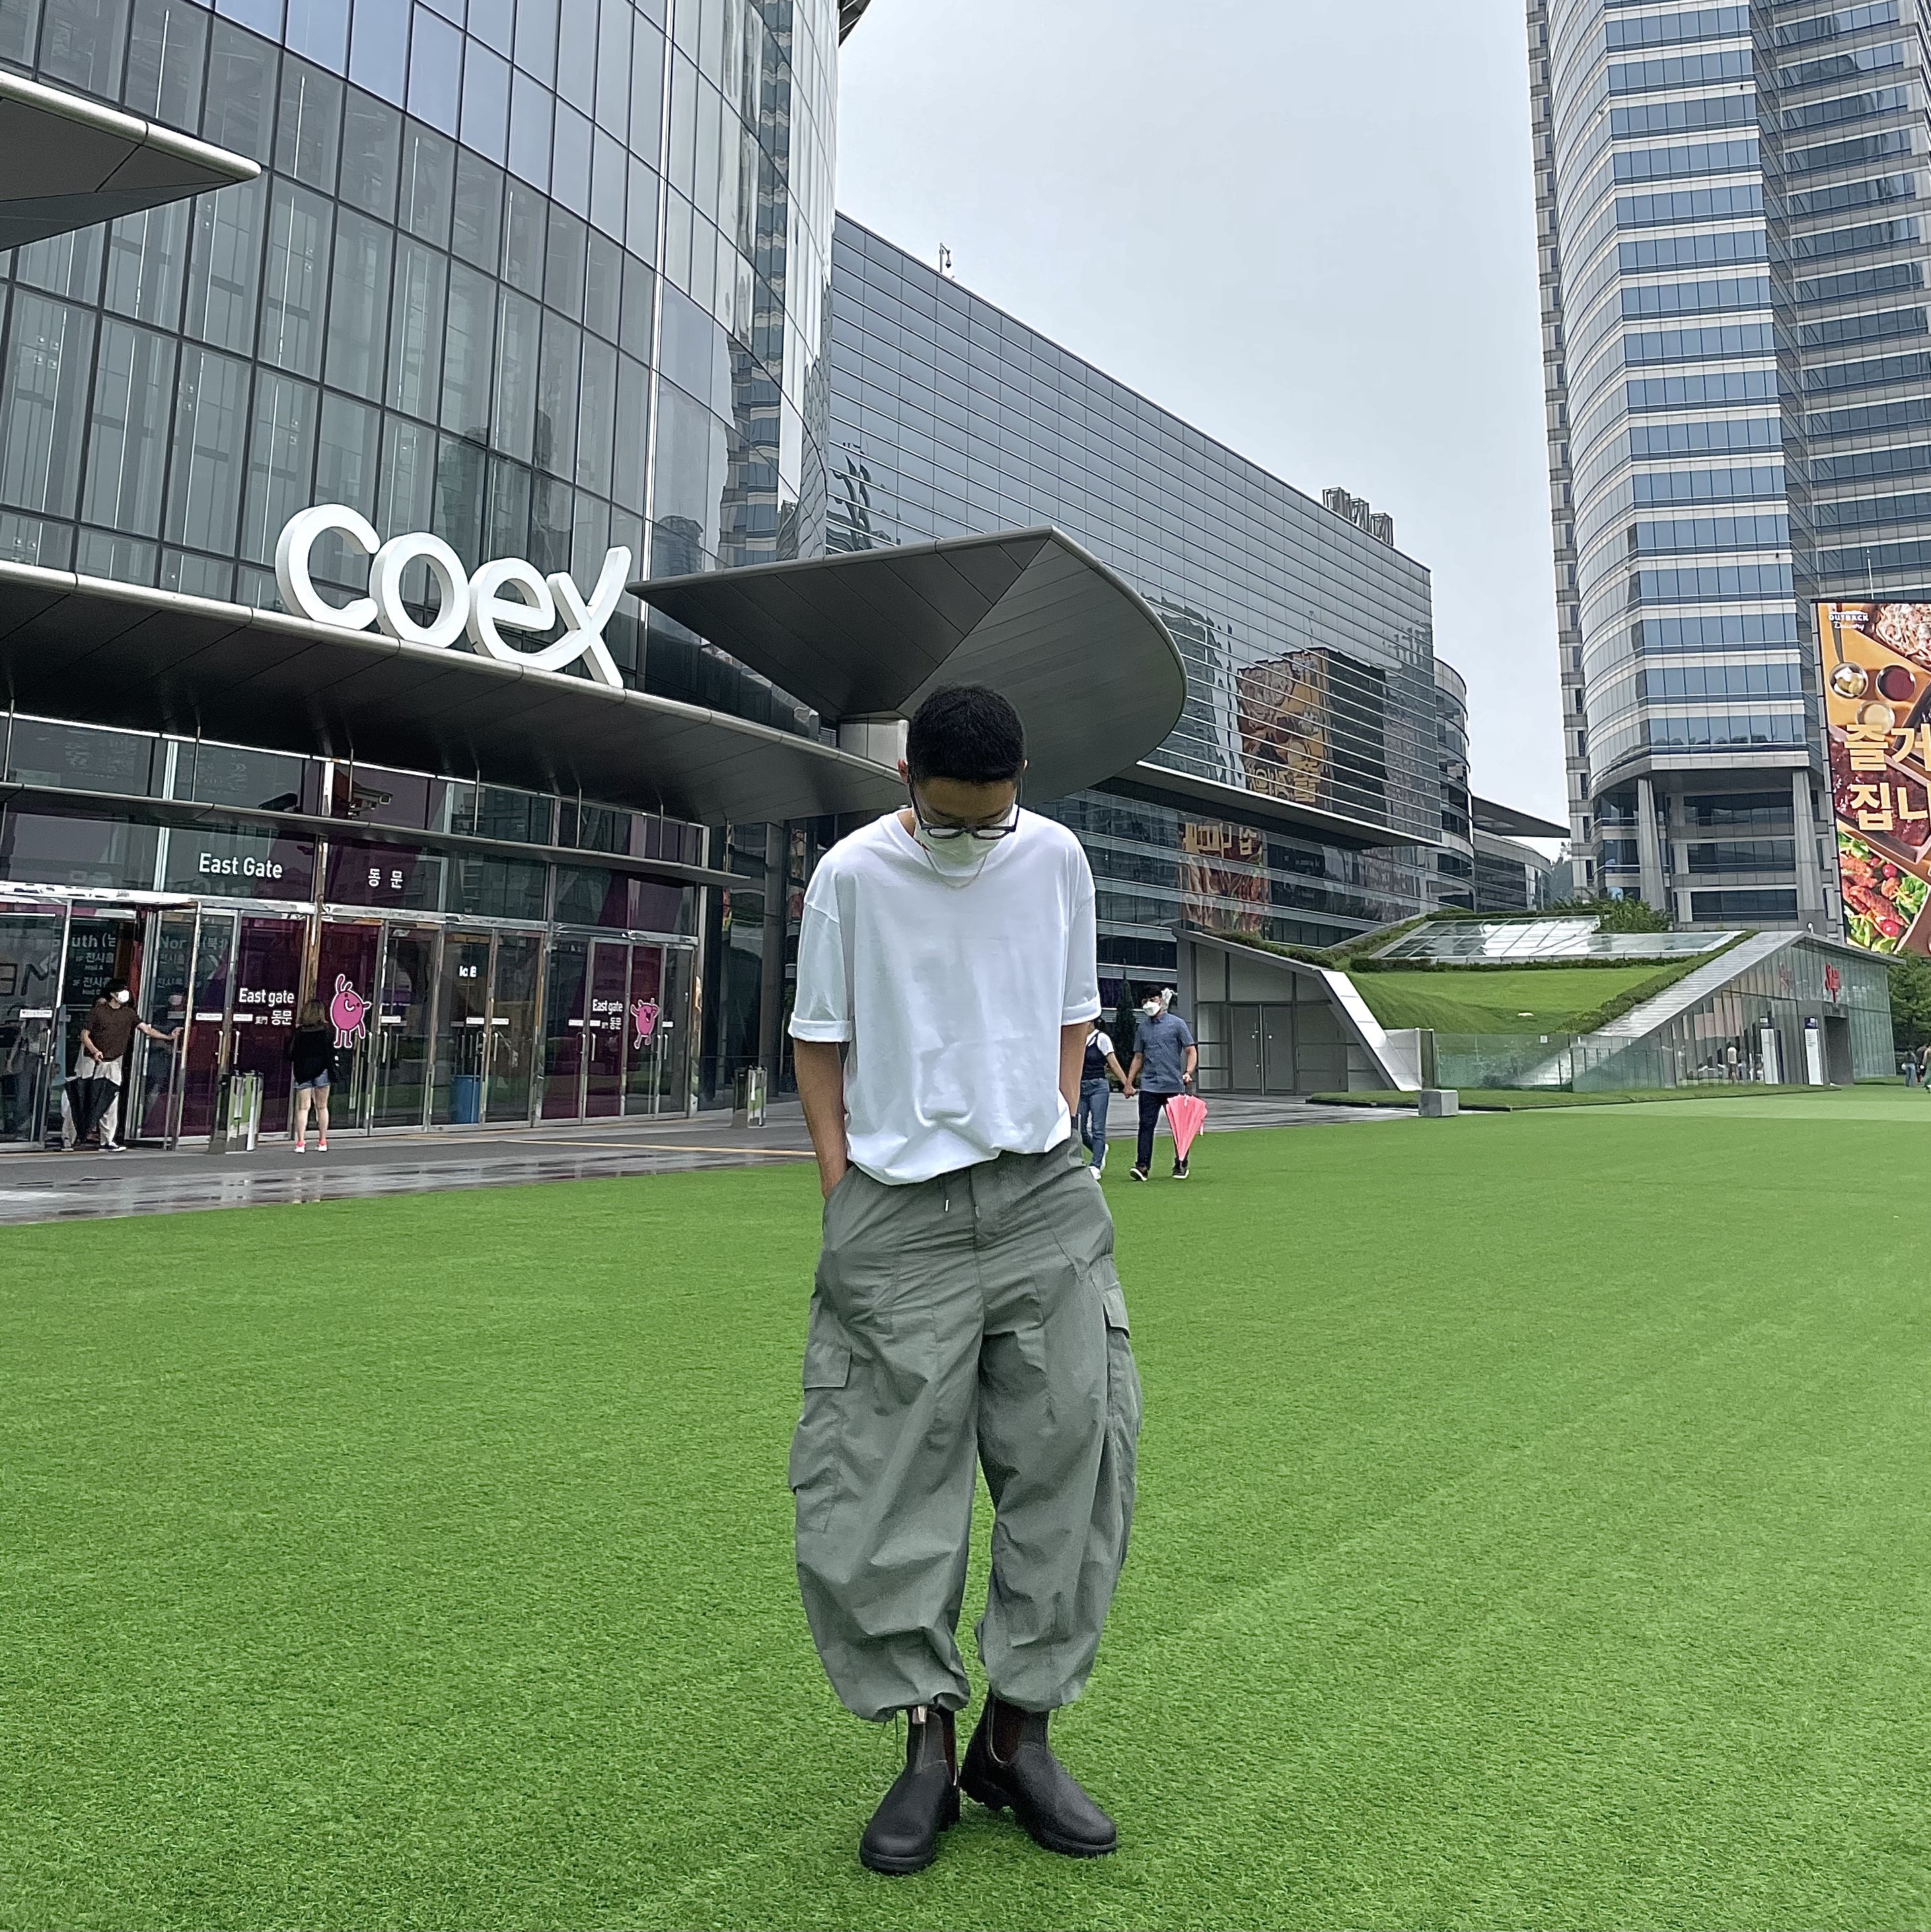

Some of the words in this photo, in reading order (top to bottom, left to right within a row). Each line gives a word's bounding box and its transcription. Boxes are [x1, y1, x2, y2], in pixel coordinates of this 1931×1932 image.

[1833, 621, 1865, 631] Delivery
[198, 852, 238, 874] East
[243, 857, 283, 878] Gate
[239, 987, 266, 1003] East
[268, 990, 295, 1007] gate
[592, 999, 608, 1011] East
[608, 1001, 623, 1015] gate
[270, 1010, 293, 1026] 동문
